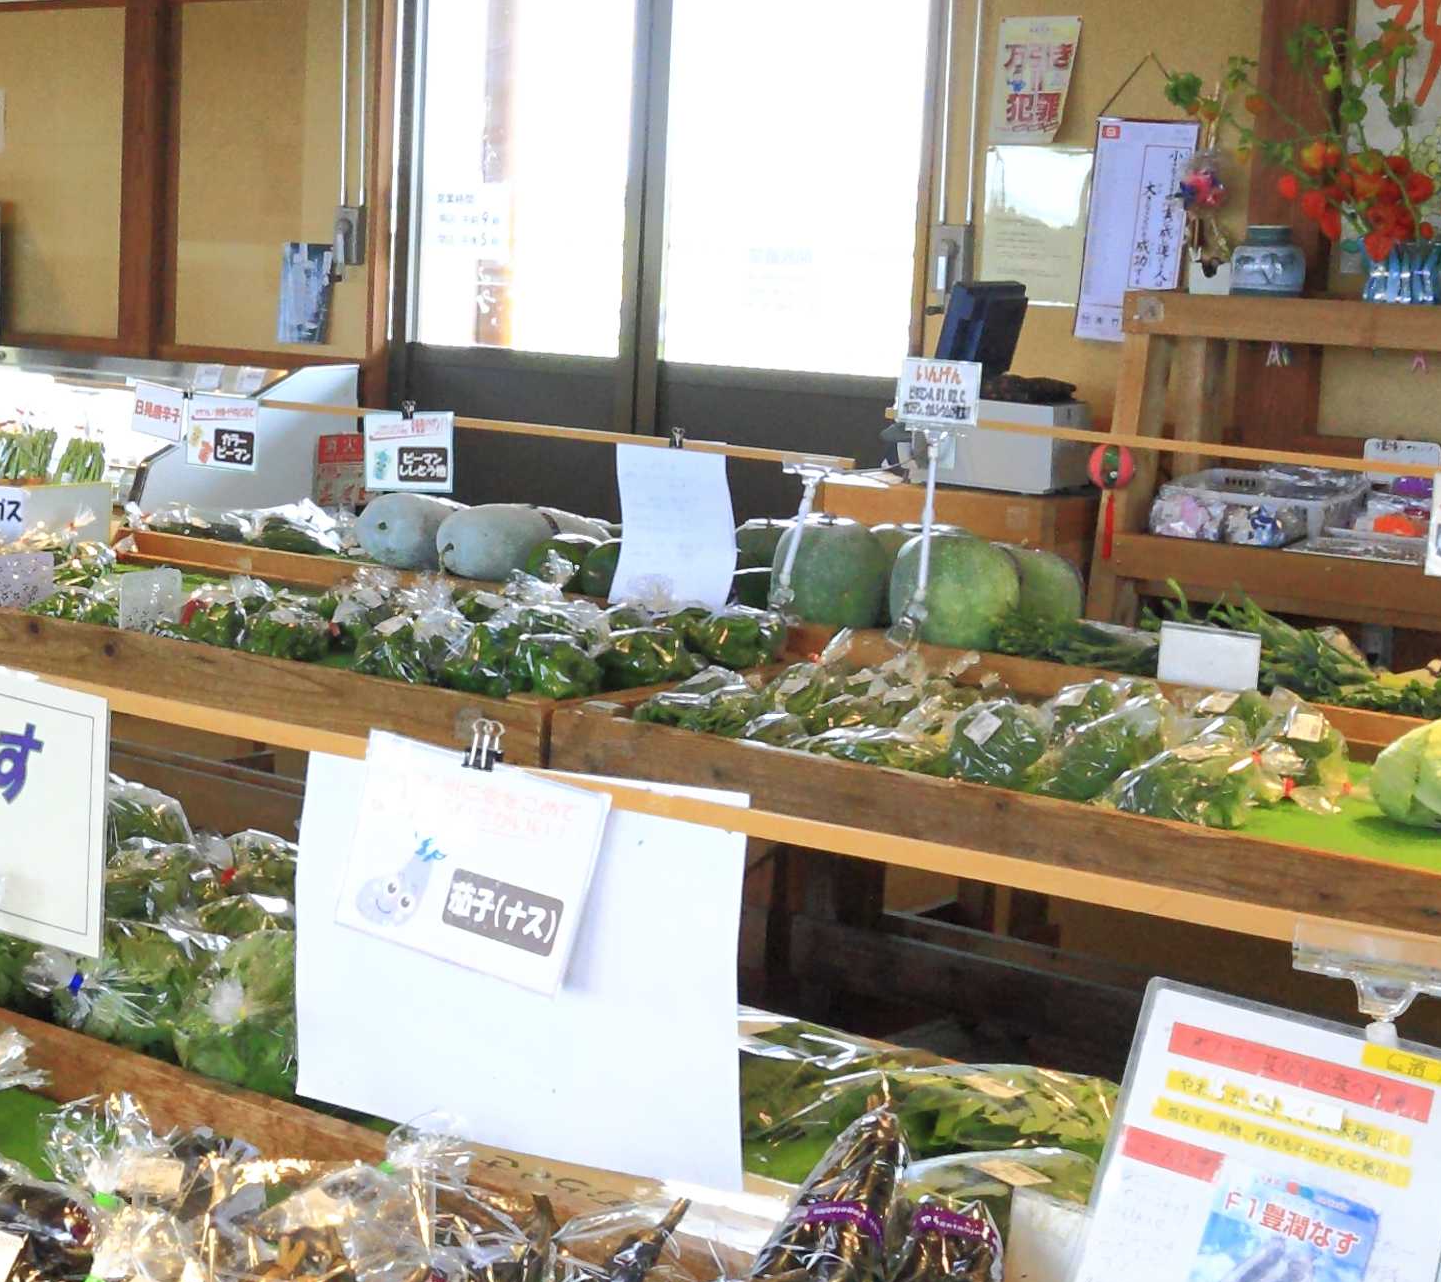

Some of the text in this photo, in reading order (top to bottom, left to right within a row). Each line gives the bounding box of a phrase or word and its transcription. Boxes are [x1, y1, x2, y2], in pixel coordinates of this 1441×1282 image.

[1006, 92, 1061, 123] 犯罪
[916, 364, 963, 385] いんげん
[216, 444, 251, 463] ピーマン
[402, 451, 444, 465] ピーマン
[447, 880, 558, 945] 茄子(ナス)
